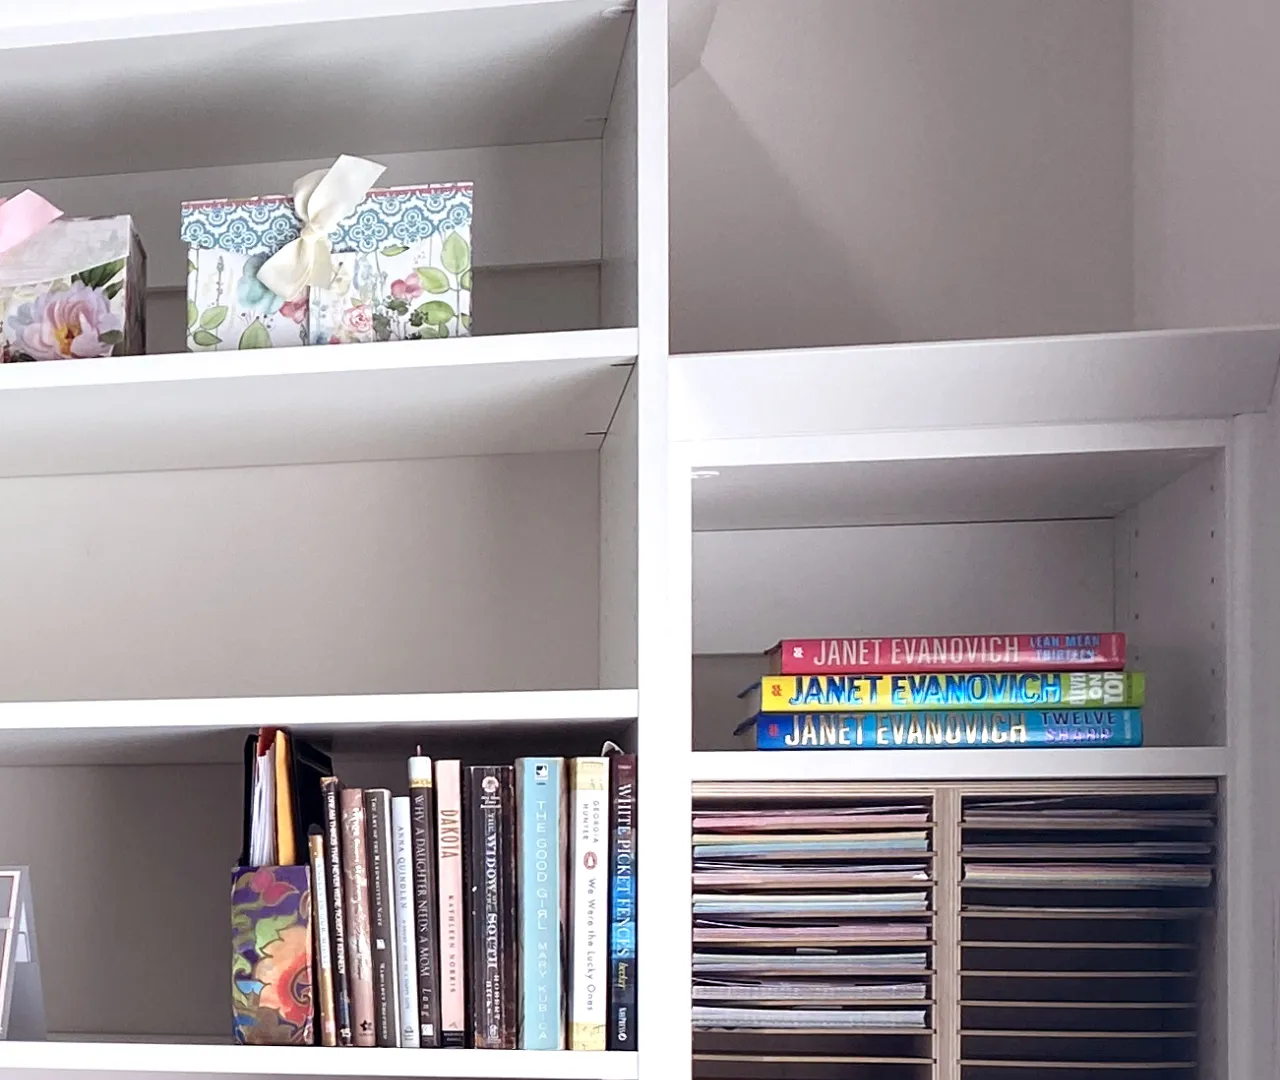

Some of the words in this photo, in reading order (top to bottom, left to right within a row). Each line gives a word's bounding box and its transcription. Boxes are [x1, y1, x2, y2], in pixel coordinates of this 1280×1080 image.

[814, 639, 882, 666] JANET
[891, 636, 1019, 665] EVANOVICH
[1065, 634, 1101, 648] MEAN
[789, 676, 882, 706] JANET
[891, 673, 1062, 705] EVANOVICH
[1089, 674, 1102, 699] ON
[1103, 672, 1124, 705] TOP
[785, 715, 864, 747] JANET
[877, 713, 1027, 746] EVANOVICH
[1041, 711, 1117, 725] TWELVE
[1045, 727, 1112, 742] SHARP
[414, 795, 424, 822] WHY
[536, 801, 547, 832] THE
[617, 784, 632, 835] WHITE
[441, 810, 459, 858] DAKOTA
[415, 838, 426, 896] DAUGHTER
[487, 832, 496, 891] WIDOW
[536, 839, 548, 882] GOOD
[617, 839, 632, 893] PICKET
[397, 857, 407, 909] QUINDLEN
[588, 879, 596, 894] We
[418, 901, 429, 932] NEEDS
[537, 888, 548, 929] GIRL
[587, 899, 595, 926] Were
[487, 913, 498, 968] SOUTH
[587, 930, 595, 946] the
[617, 899, 631, 957] FENCES
[419, 947, 430, 976] MOM
[538, 942, 547, 977] MARY
[585, 951, 596, 979] Lucky
[421, 989, 432, 1017] Lang
[537, 985, 547, 1040] KUBICA
[587, 985, 595, 1011] Ones
